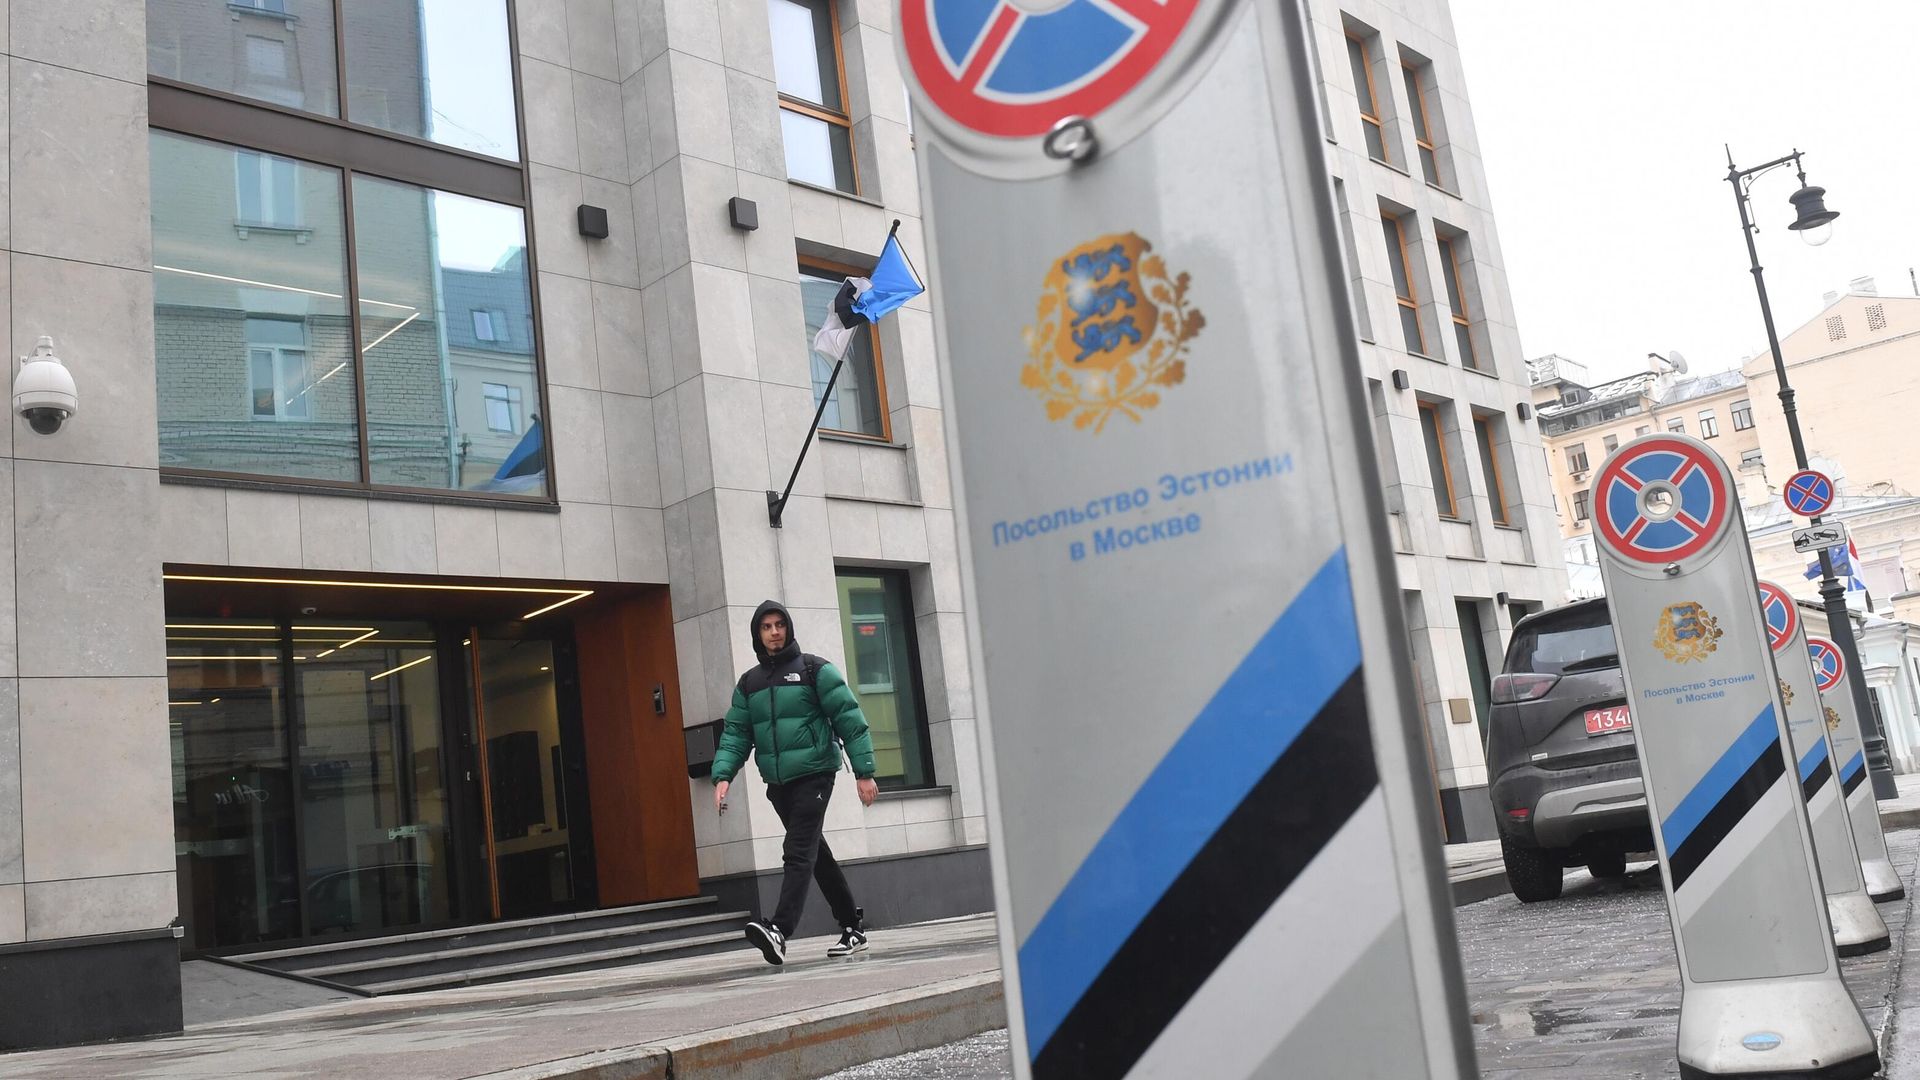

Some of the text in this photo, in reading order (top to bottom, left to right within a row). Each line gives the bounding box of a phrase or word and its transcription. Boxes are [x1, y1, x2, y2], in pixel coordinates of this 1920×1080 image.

[991, 453, 1294, 547] Посольство Эстонии
[1069, 512, 1201, 561] в Москве
[1643, 673, 1755, 698] Посольство Эстонии
[1685, 690, 1725, 702] Москве
